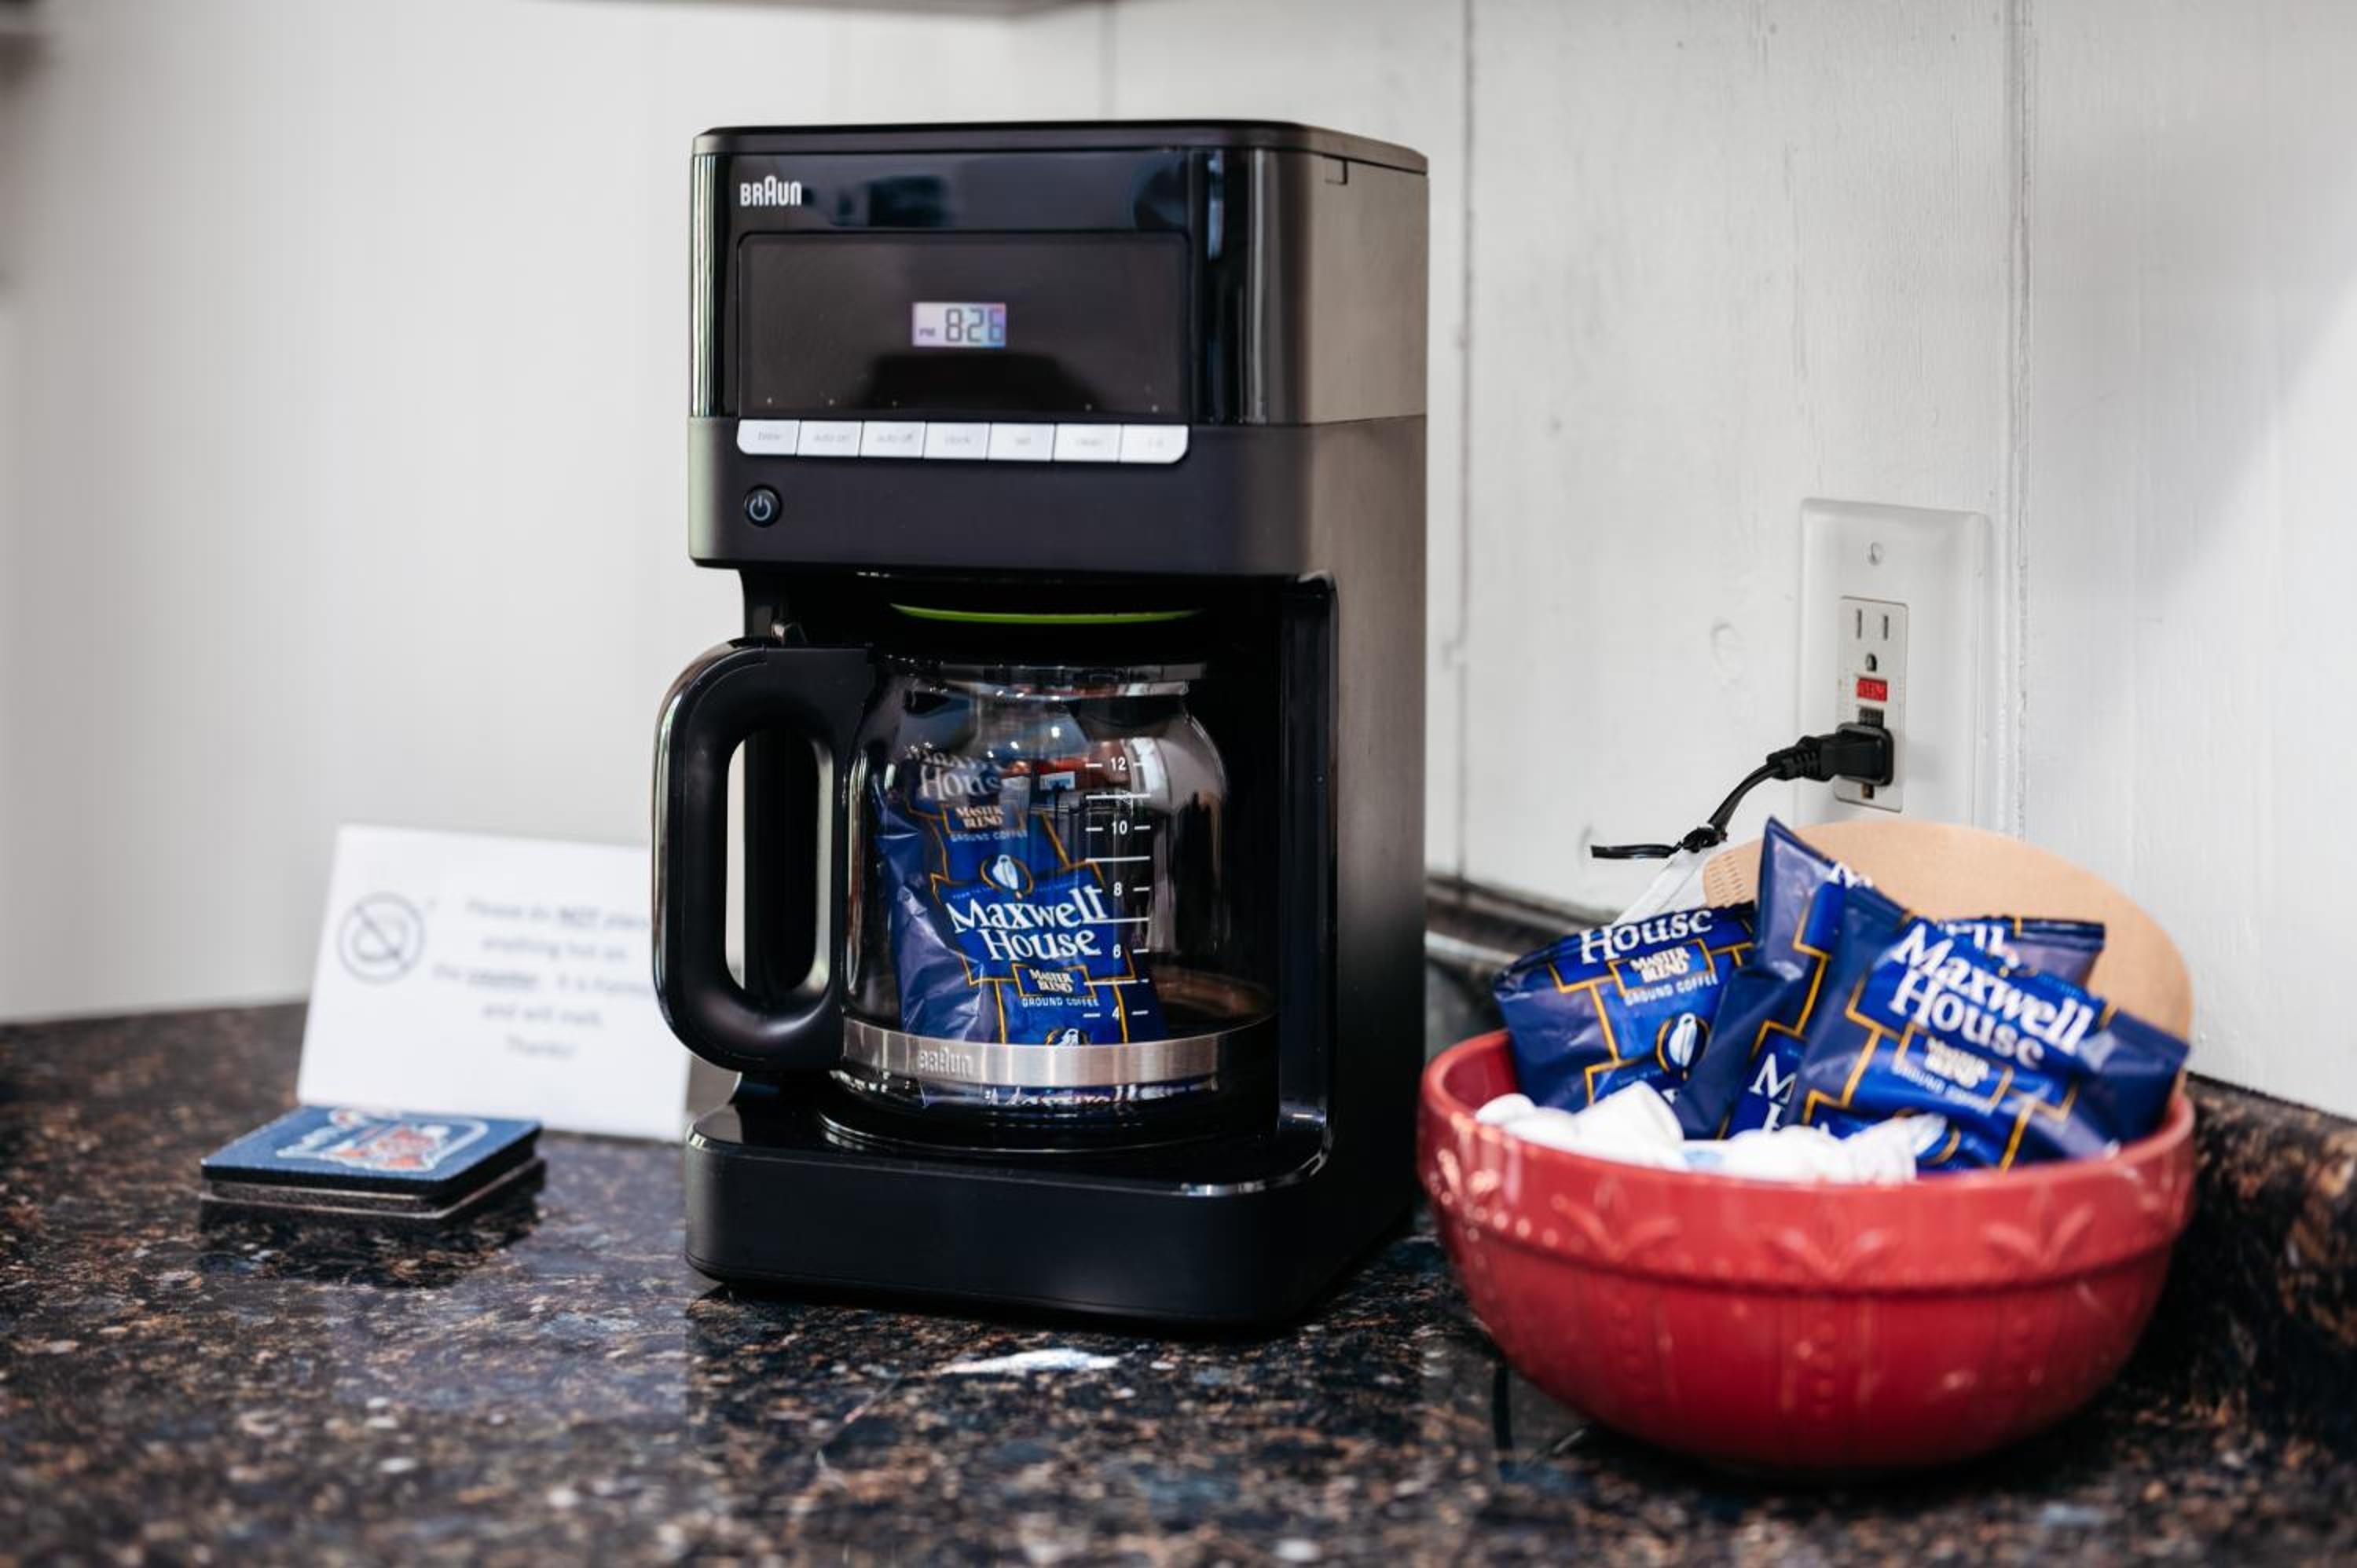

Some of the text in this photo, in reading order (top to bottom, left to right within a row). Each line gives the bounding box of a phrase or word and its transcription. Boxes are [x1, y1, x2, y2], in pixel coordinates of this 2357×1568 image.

[740, 175, 802, 207] BRAUN
[1110, 757, 1126, 771] 12
[1112, 820, 1127, 835] 10
[1113, 881, 1122, 896] 8
[946, 885, 1108, 934] Maxwell
[977, 929, 1102, 962] House
[1579, 909, 1713, 965] House
[1113, 944, 1121, 958] 6
[1890, 922, 2095, 1057] Maxwell
[1022, 997, 1063, 1008] GROUND
[1112, 1006, 1121, 1020] 4
[1887, 966, 2045, 1068] House
